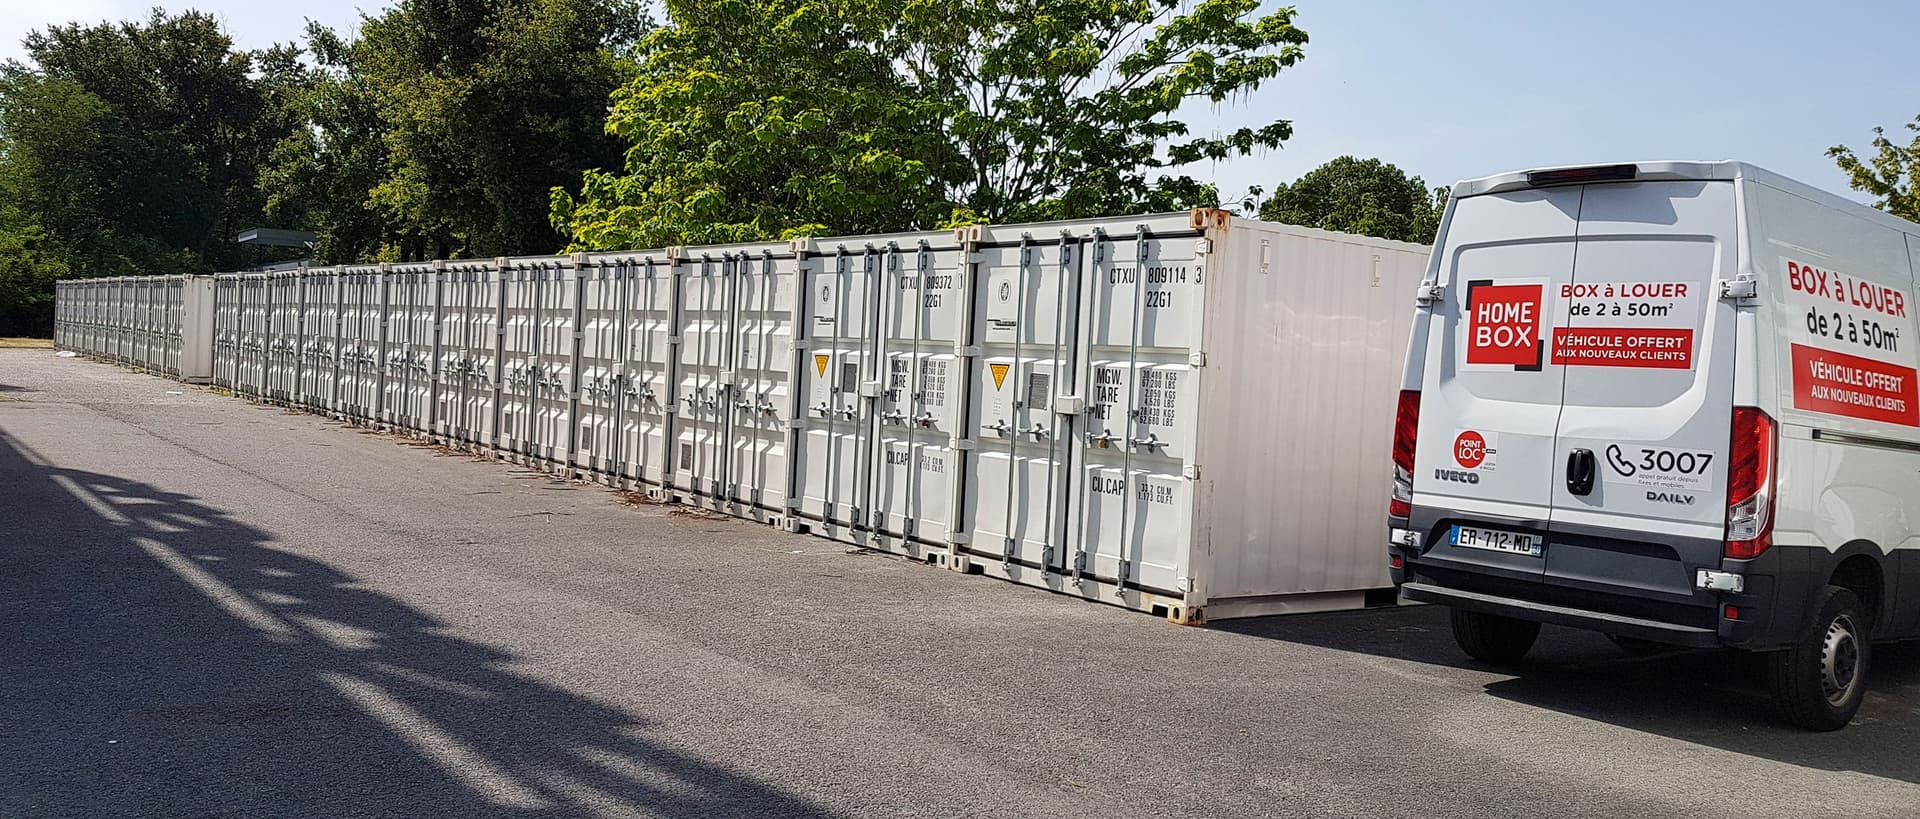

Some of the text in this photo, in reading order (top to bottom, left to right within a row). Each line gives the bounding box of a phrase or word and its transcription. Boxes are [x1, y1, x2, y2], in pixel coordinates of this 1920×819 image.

[900, 276, 918, 290] CTXU
[926, 275, 953, 290] 809372
[1110, 266, 1203, 284] CTXU 809114 3
[1560, 283, 1688, 298] BOX à LOUER
[1788, 261, 1906, 318] BOX à LOUER
[924, 294, 943, 308] 22G1
[1146, 291, 1172, 308] 22G1
[1477, 302, 1534, 324] HOME
[1570, 303, 1591, 316] de
[1595, 303, 1606, 316] 2
[1611, 302, 1622, 316] à
[1806, 306, 1828, 337] de
[1832, 312, 1844, 340] 2
[1848, 314, 1858, 343] à
[1475, 325, 1532, 348] BOX
[1557, 333, 1623, 348] VÉHICULE
[1556, 349, 1686, 361] AUX NOUVEAUX CLIENTS
[1096, 368, 1122, 385] MGW.
[1166, 371, 1177, 381] KGS
[1810, 357, 1863, 386] VÉHICULE
[892, 374, 906, 388] TARE
[1164, 381, 1175, 389] LBS
[889, 389, 902, 403] NET
[1096, 385, 1119, 403] TARE
[1165, 390, 1176, 400] KGS
[1811, 385, 1906, 413] AUX NOUVEAUX CLIENTS
[1095, 404, 1112, 420] NET
[1163, 409, 1175, 418] KGS
[1163, 400, 1175, 409] LBS
[1162, 418, 1173, 427] LBS
[1460, 439, 1482, 449] POINT
[1459, 447, 1481, 461] LOC
[1639, 449, 1713, 475] 3007
[1434, 468, 1480, 485] IVECO
[1092, 476, 1124, 496] CU.CAP
[1646, 491, 1695, 506] DAILY
